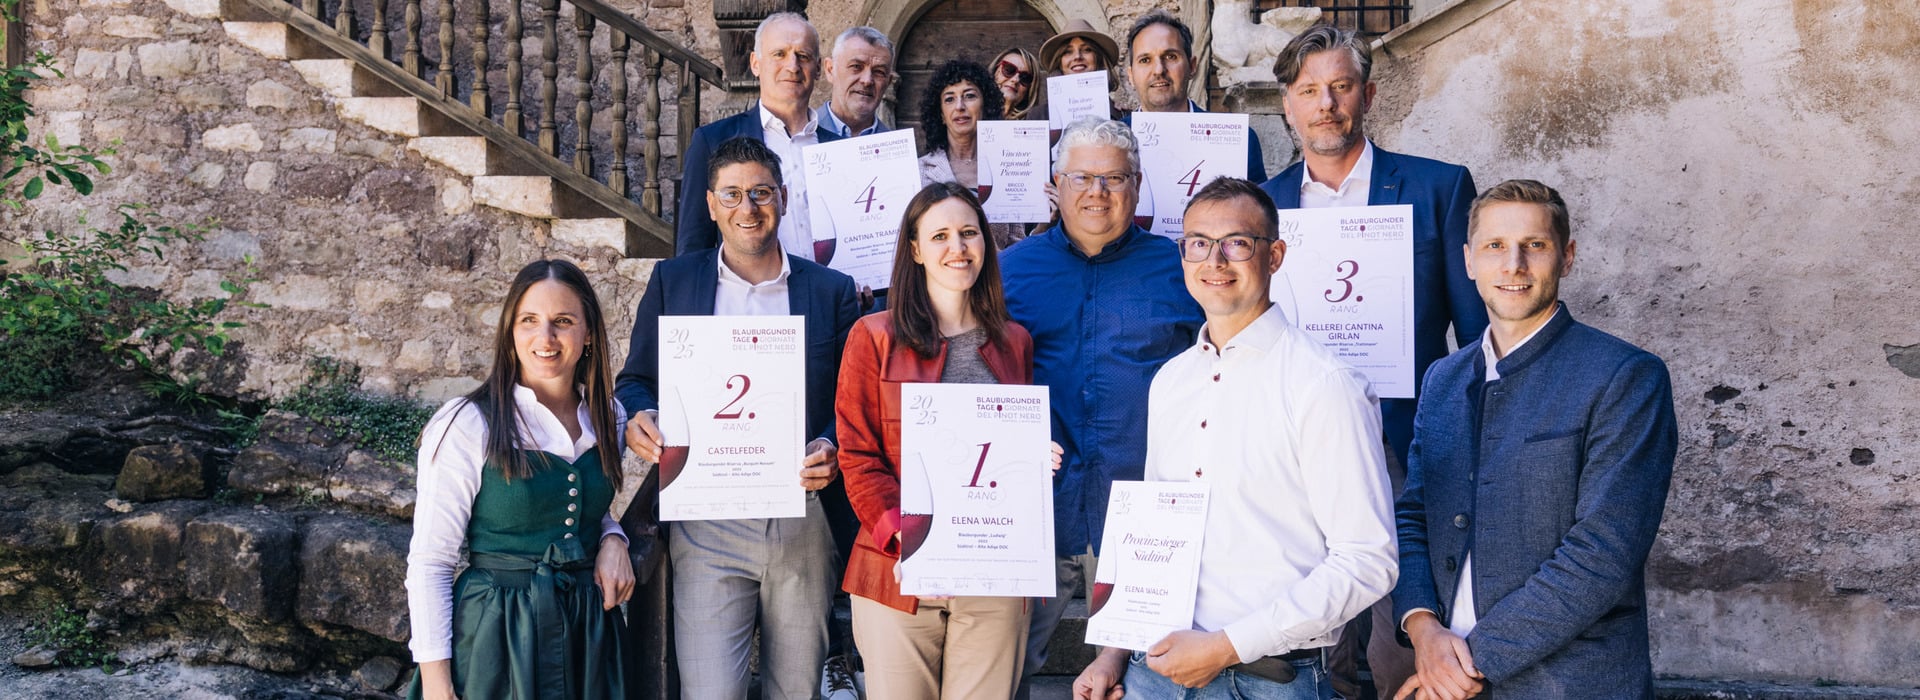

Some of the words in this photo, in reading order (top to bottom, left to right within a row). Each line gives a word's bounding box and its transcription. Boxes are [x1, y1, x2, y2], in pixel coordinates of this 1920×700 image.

[1138, 122, 1156, 134] 20
[858, 138, 908, 150] BLAUBURGUNDER
[1142, 134, 1160, 146] 25
[810, 152, 827, 165] 20
[1000, 160, 1032, 168] regionale
[816, 163, 832, 175] 25
[854, 176, 885, 213] 4.
[1279, 220, 1299, 234] 20
[844, 233, 874, 243] CANTINA
[1286, 234, 1303, 248] 25
[1324, 260, 1364, 303] 3.
[1330, 305, 1358, 314] RANG
[667, 328, 689, 343] 20
[673, 344, 694, 359] 25
[714, 374, 756, 420] 2.
[910, 395, 933, 410] 20
[915, 410, 938, 425] 25
[722, 423, 751, 432] RANG
[708, 446, 766, 455] CASTELFEDER
[961, 442, 997, 488] 1.
[968, 491, 997, 501] RANG
[1114, 491, 1130, 502] 20
[1116, 503, 1131, 515] 25
[982, 517, 1013, 525] WALCH
[1122, 533, 1188, 550] Provinzsieger
[1132, 550, 1173, 563] Südtirol
[1146, 587, 1168, 596] WALCH
